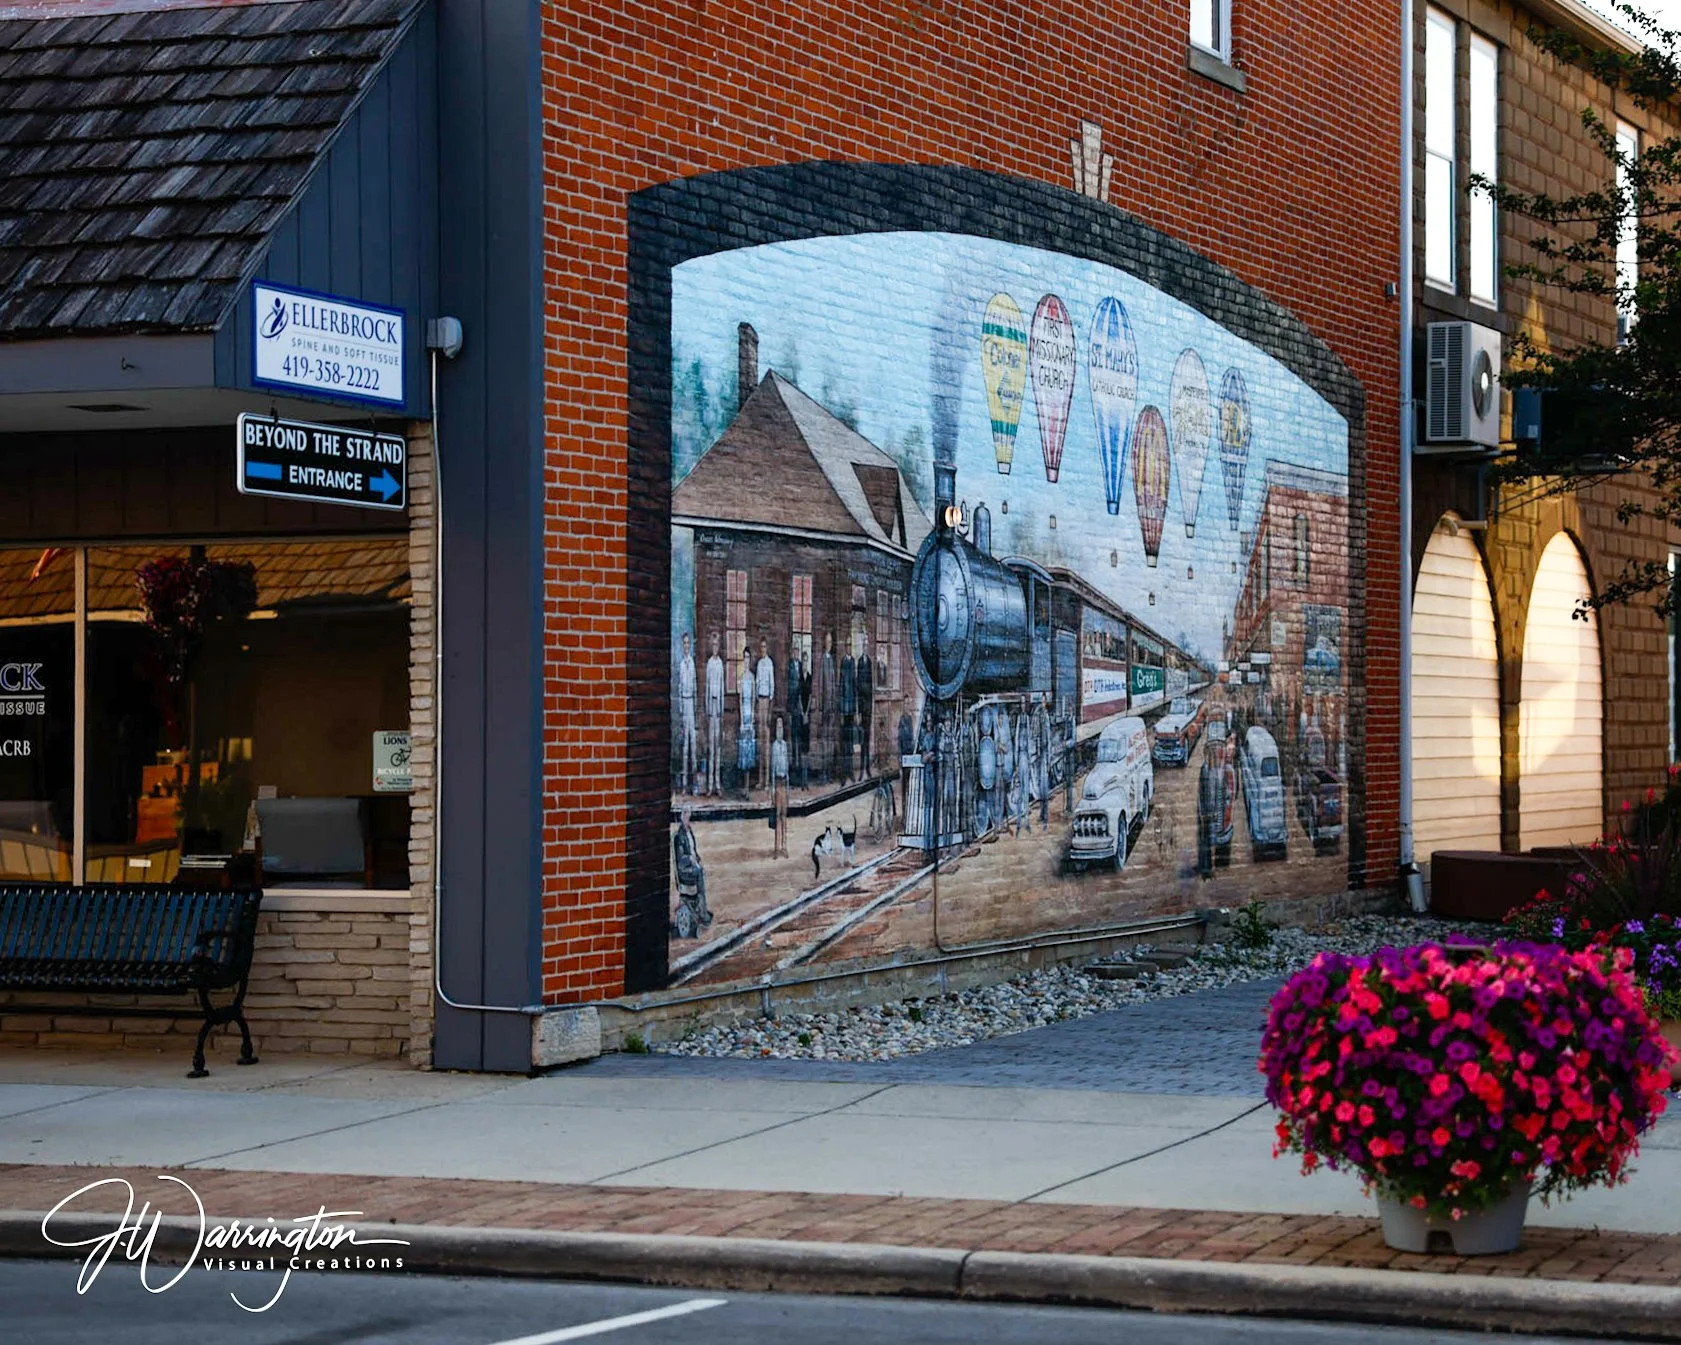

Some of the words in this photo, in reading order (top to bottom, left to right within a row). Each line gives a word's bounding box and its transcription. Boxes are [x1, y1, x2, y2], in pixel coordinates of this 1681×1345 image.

[292, 303, 397, 344] ELLERBROCK
[291, 337, 318, 351] SPINE
[322, 342, 340, 355] AND
[344, 347, 366, 361] SOFT
[370, 352, 400, 366] TISSUE
[283, 355, 380, 390] 419-358-2222
[245, 423, 307, 451] BEYOND
[313, 433, 341, 456] THE
[346, 438, 402, 465] STRAND
[289, 465, 363, 491] ENTRANCE
[383, 737, 407, 745] LIONS
